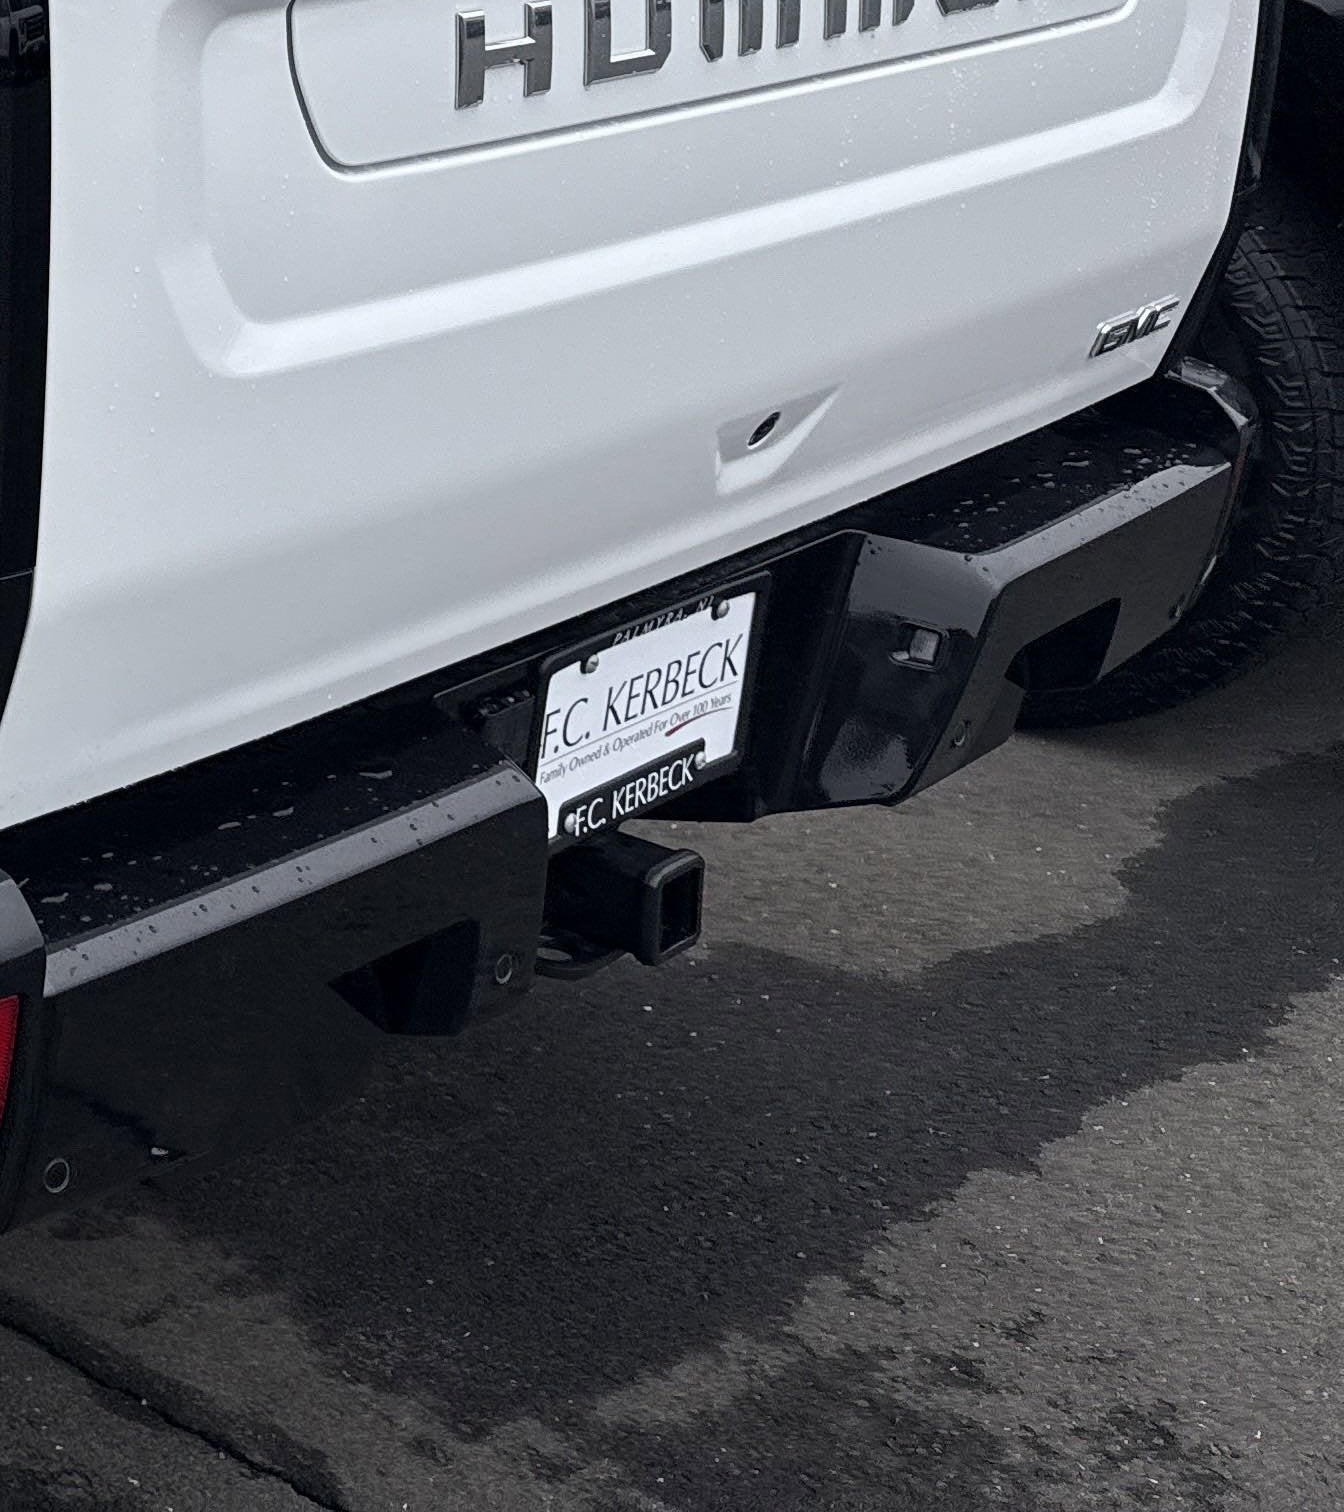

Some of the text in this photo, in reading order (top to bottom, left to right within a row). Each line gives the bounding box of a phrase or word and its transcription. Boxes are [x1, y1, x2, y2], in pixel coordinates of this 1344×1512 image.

[1087, 294, 1180, 359] GMC
[539, 693, 733, 786] Family Owned & Operated For Over 100 Years
[540, 634, 744, 759] F.C. KERBECK
[574, 752, 697, 837] F.C. KERBECK
